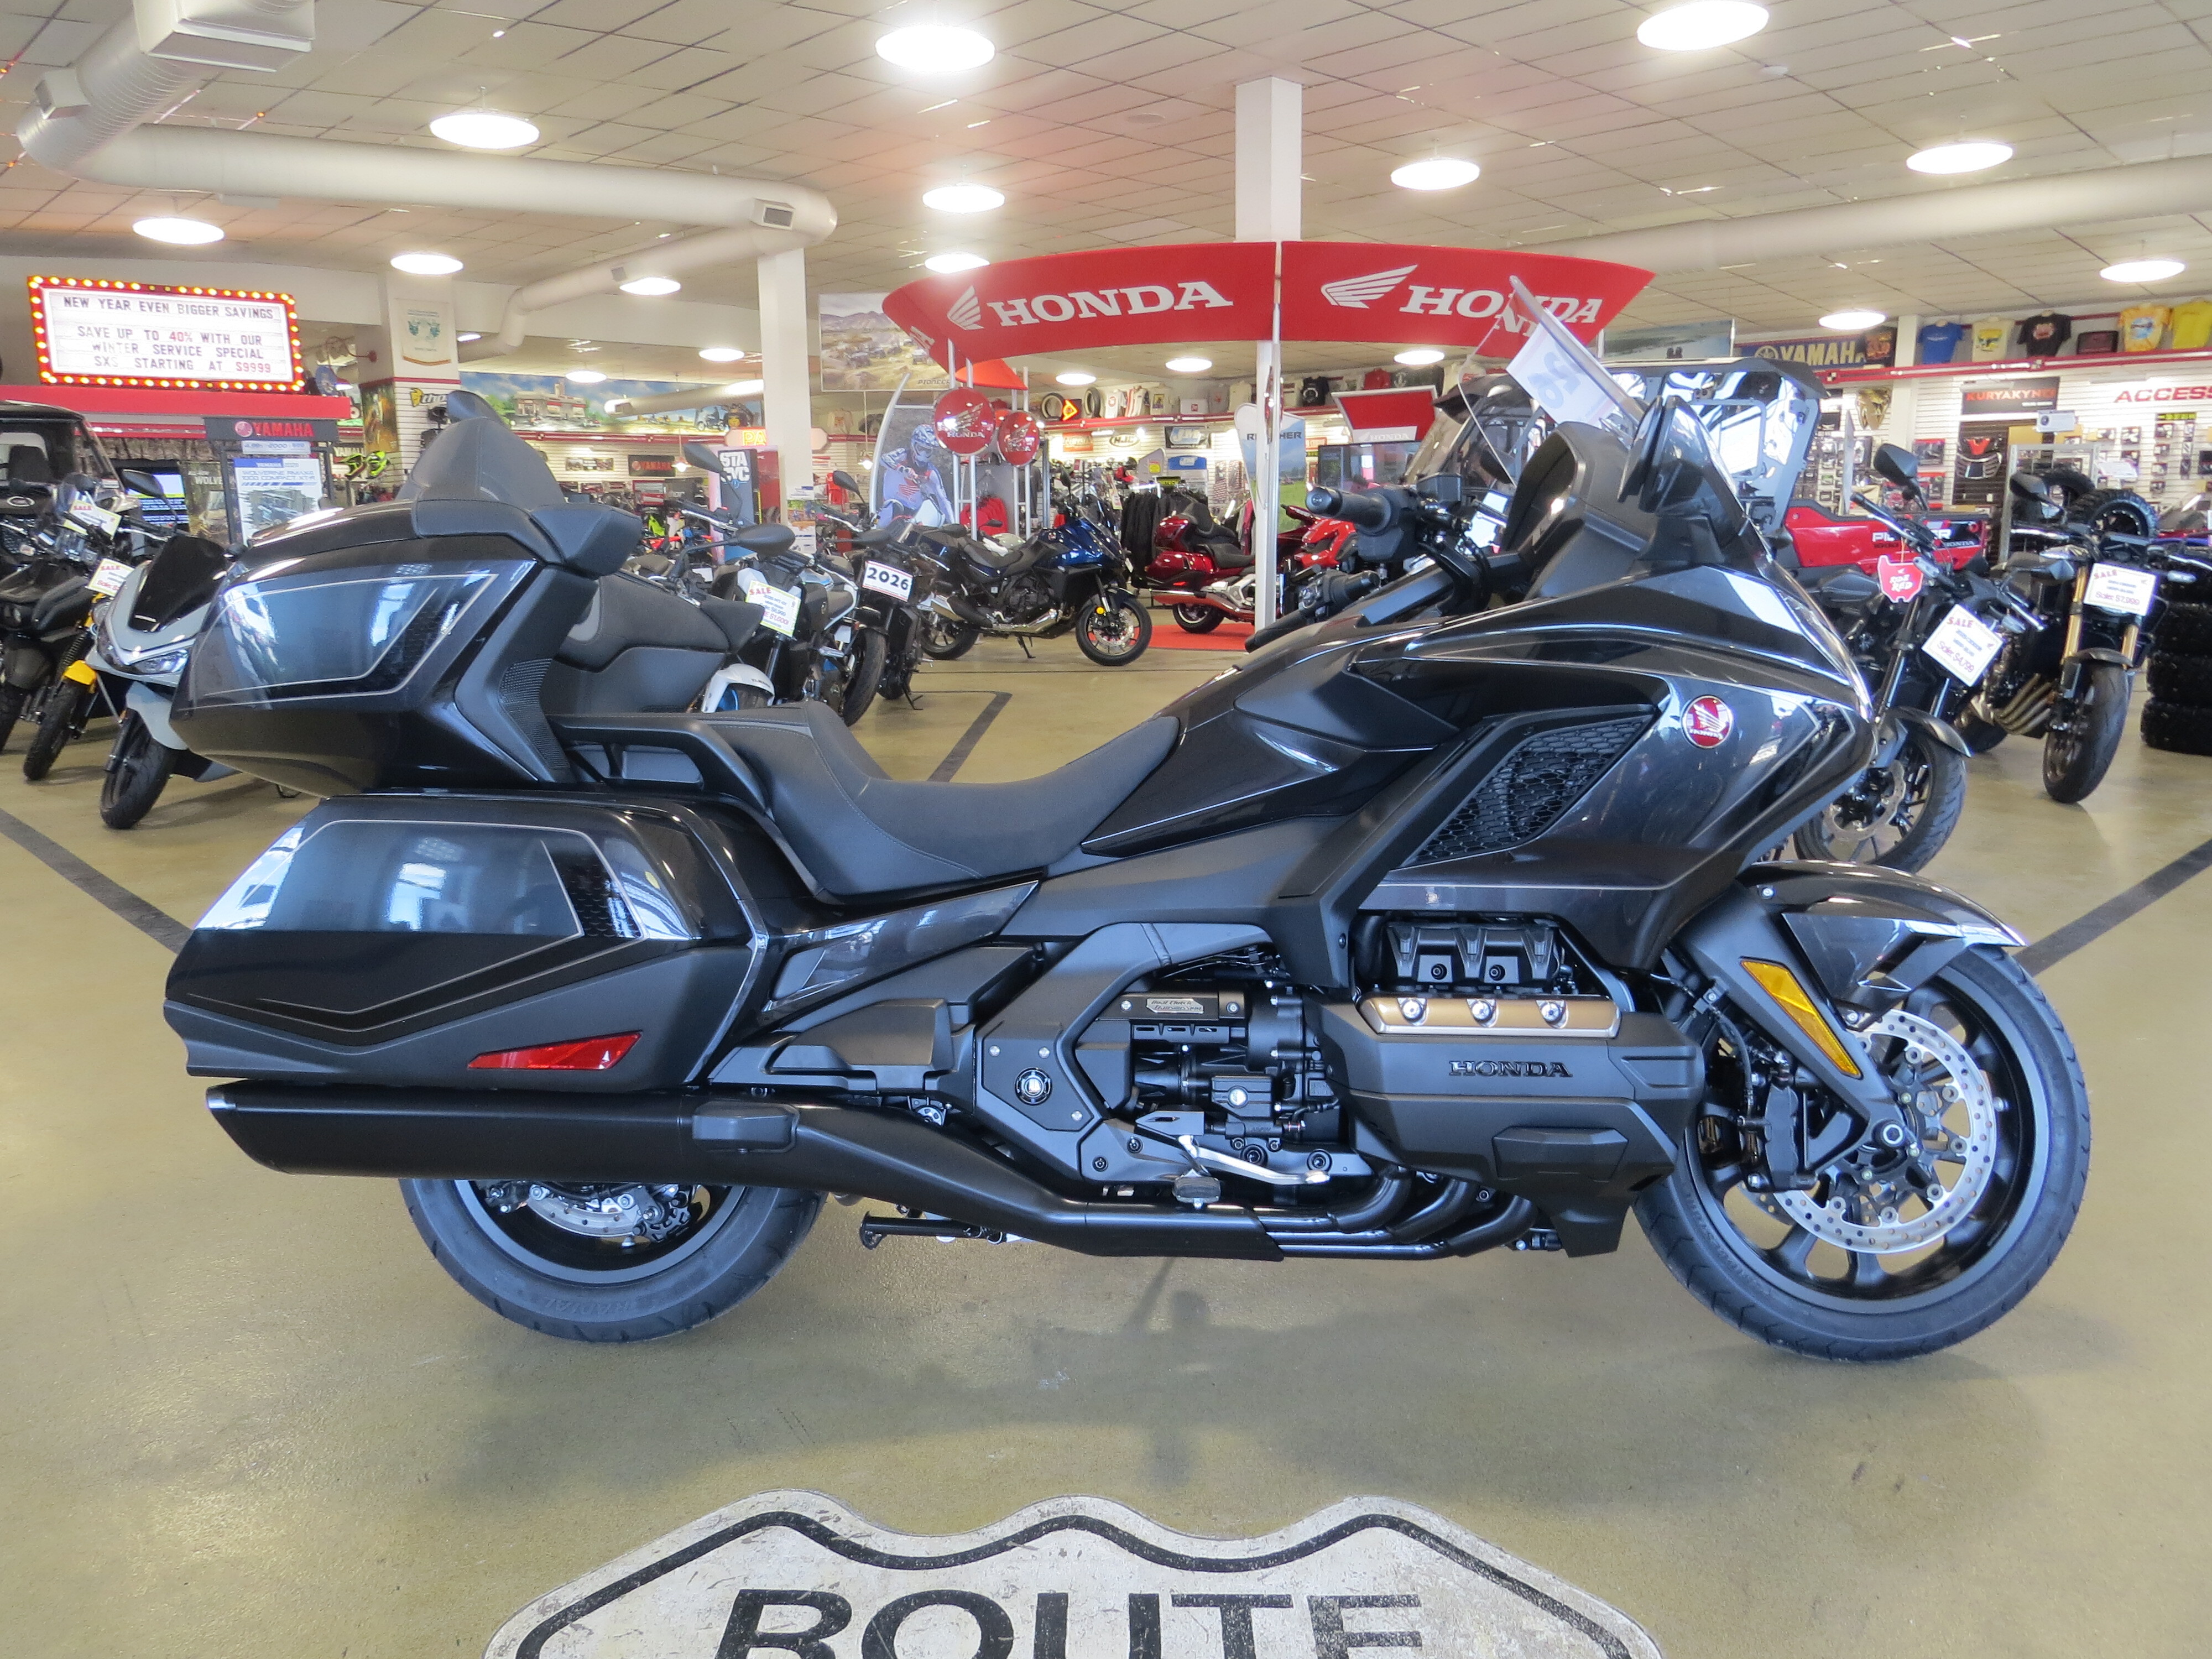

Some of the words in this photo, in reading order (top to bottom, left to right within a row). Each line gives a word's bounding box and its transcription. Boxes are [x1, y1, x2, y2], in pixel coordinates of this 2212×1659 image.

[64, 296, 90, 308] NEW
[98, 298, 132, 310] YEAR
[139, 301, 170, 314] EVEN
[178, 304, 220, 316] BIGGER
[225, 306, 273, 319] SAVINGS
[987, 280, 1234, 327] HONDA
[77, 326, 111, 338] SAVE
[117, 328, 133, 339] UP
[144, 330, 159, 341] TO
[169, 331, 193, 342] 40%
[200, 332, 231, 344] WITH
[241, 335, 262, 346] OUR
[92, 342, 139, 354] WINTER
[152, 344, 202, 357] SERVICE
[216, 347, 264, 359] SPECIAL
[134, 357, 194, 370] STARTING
[208, 361, 222, 371] AT
[1966, 389, 2042, 401] KURYAKYN
[252, 422, 315, 437] YAMAHA
[1247, 432, 1302, 440] RHER
[867, 567, 909, 591] 2026
[1891, 582, 1913, 592] RED
[749, 587, 771, 596] SALE
[1947, 617, 1974, 628] SALE
[1448, 1060, 1573, 1078] HONDA
[715, 1589, 1422, 1659] ROUTE
